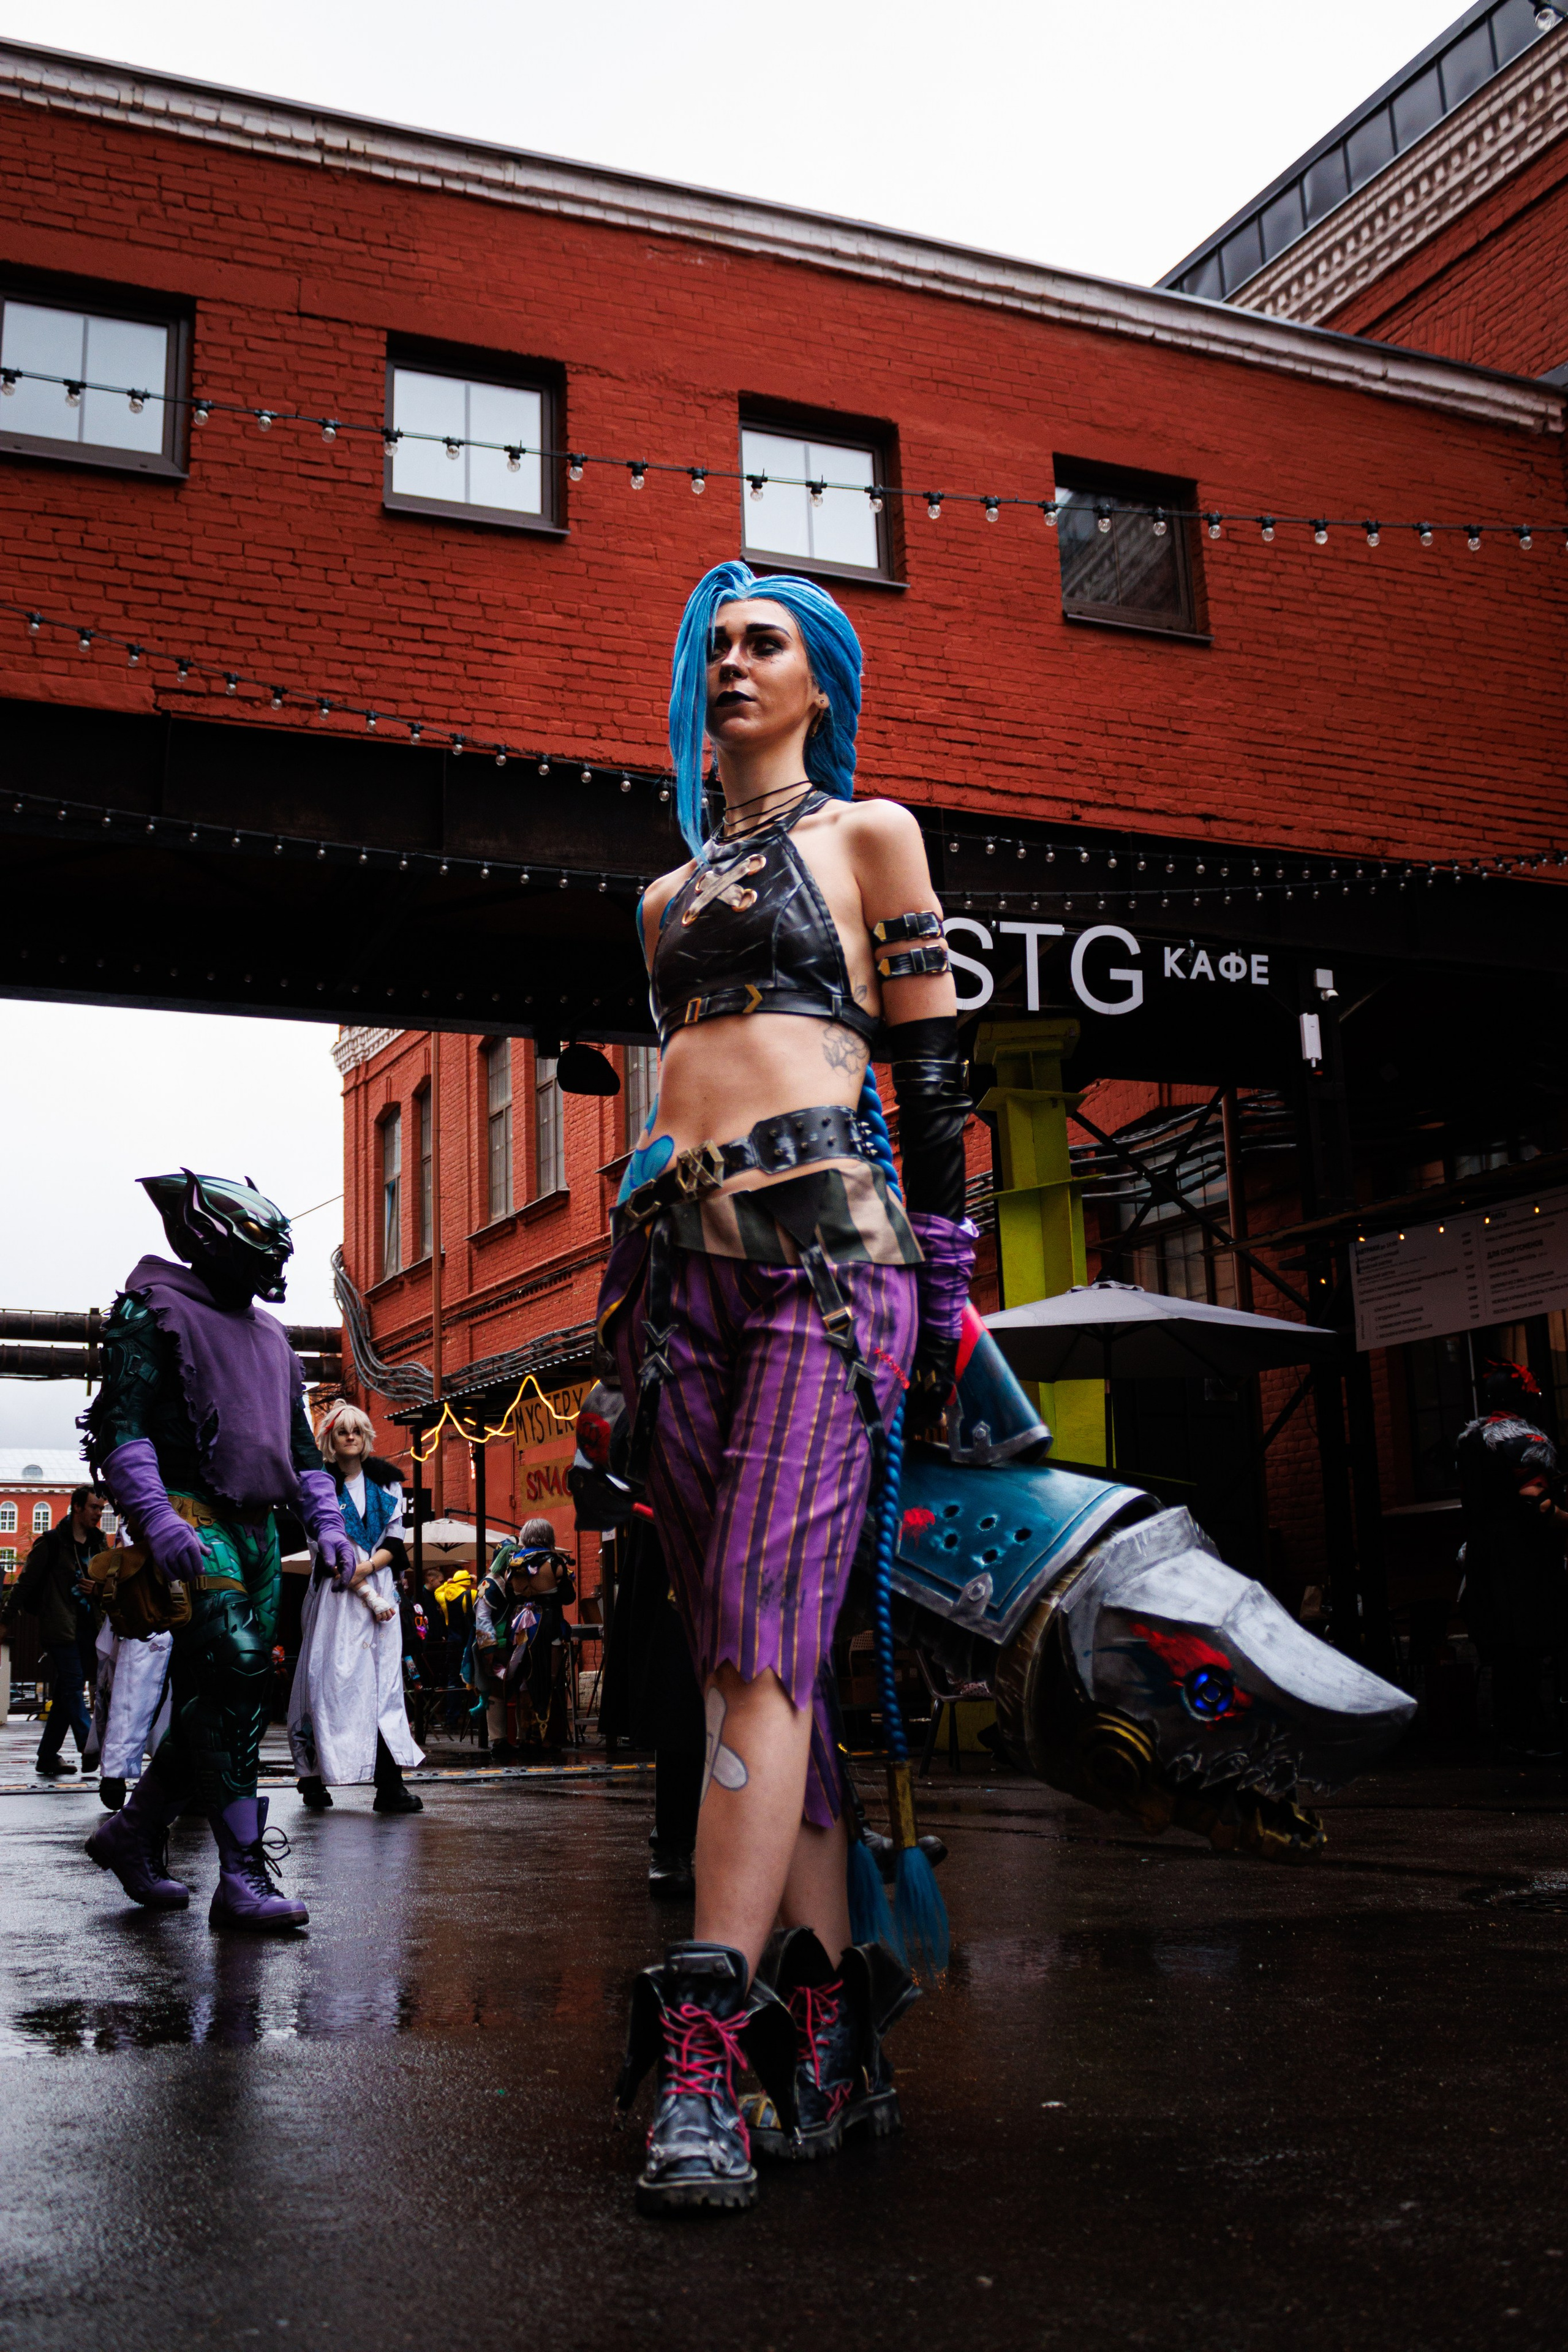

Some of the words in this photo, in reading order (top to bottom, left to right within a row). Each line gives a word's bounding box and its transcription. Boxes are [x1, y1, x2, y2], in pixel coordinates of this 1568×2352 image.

[942, 917, 1144, 1016] STG
[1164, 947, 1269, 985] КАФЕ
[514, 1387, 583, 1446] MYSTERY
[526, 1463, 574, 1501] SNAC
